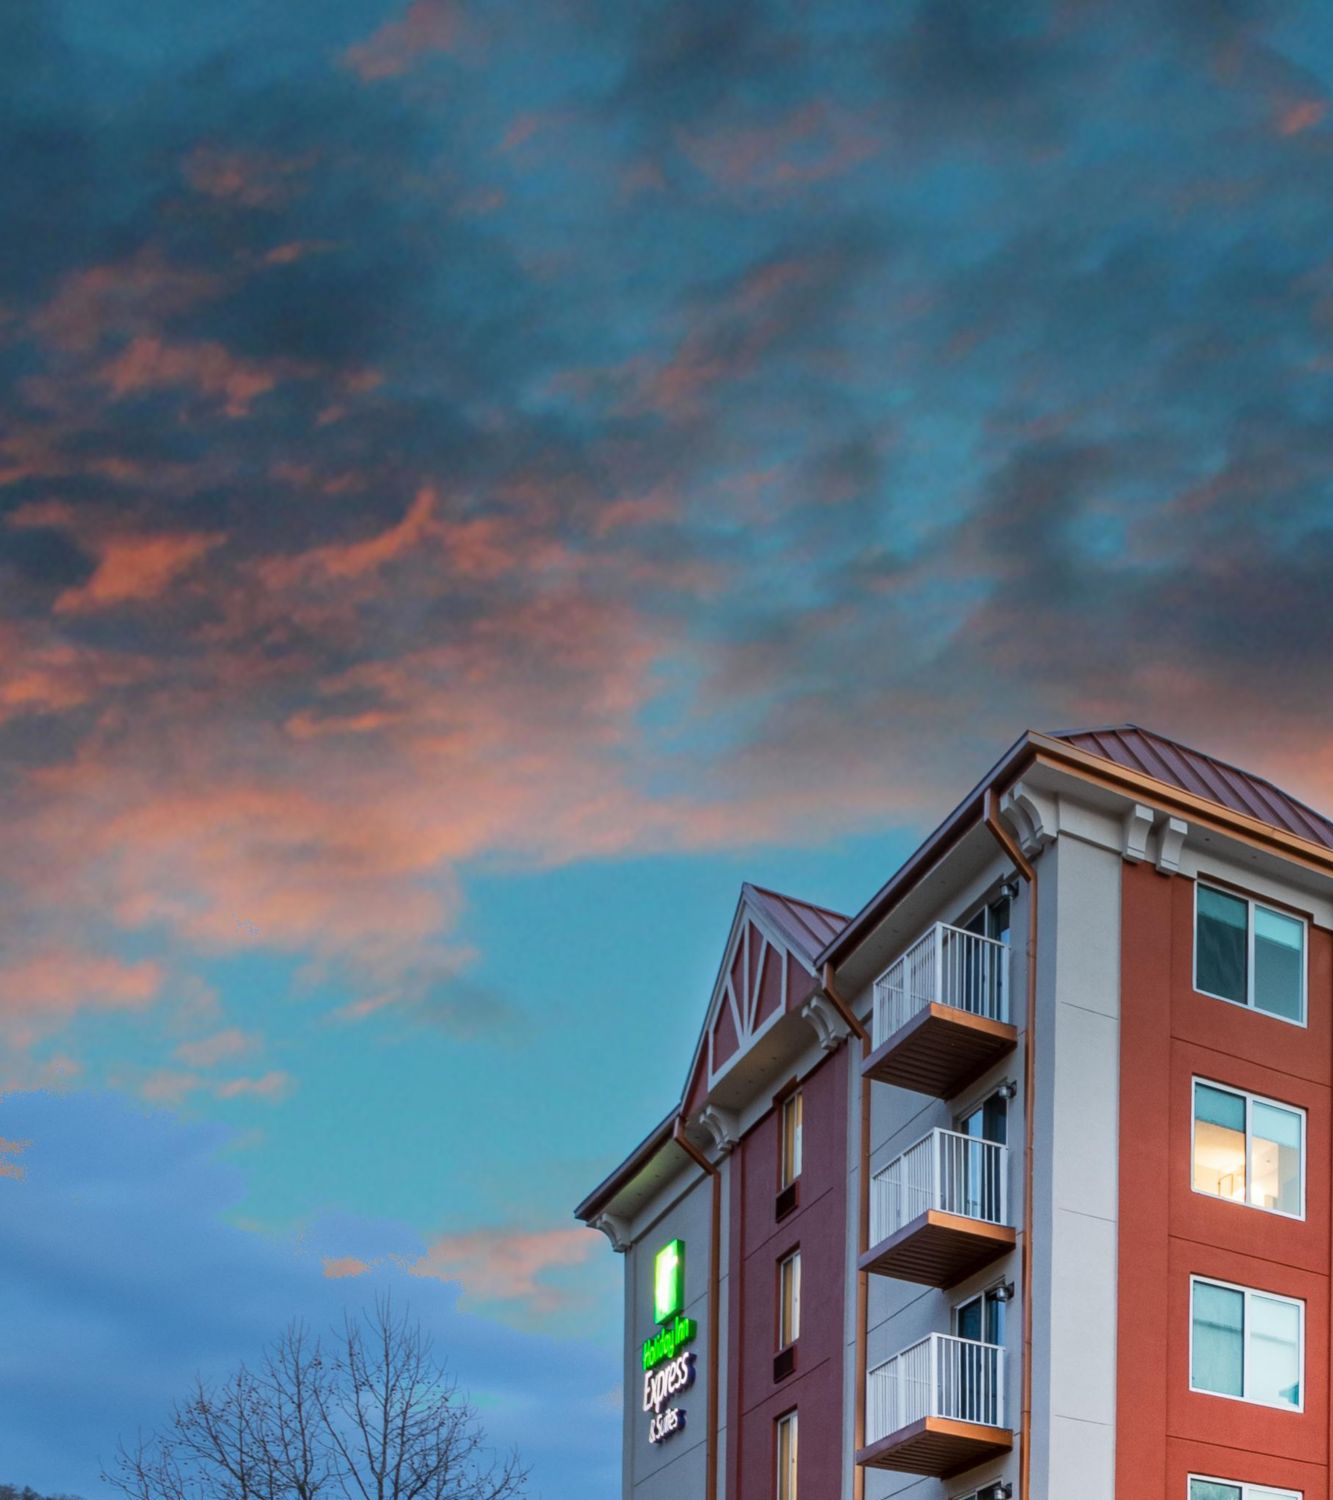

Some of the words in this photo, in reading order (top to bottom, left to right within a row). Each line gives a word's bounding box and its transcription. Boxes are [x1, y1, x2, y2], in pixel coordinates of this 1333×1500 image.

[643, 1327, 674, 1370] Holiday
[675, 1316, 689, 1346] Inn
[643, 1351, 689, 1414] Express
[649, 1419, 656, 1443] &
[656, 1408, 678, 1439] Suites
